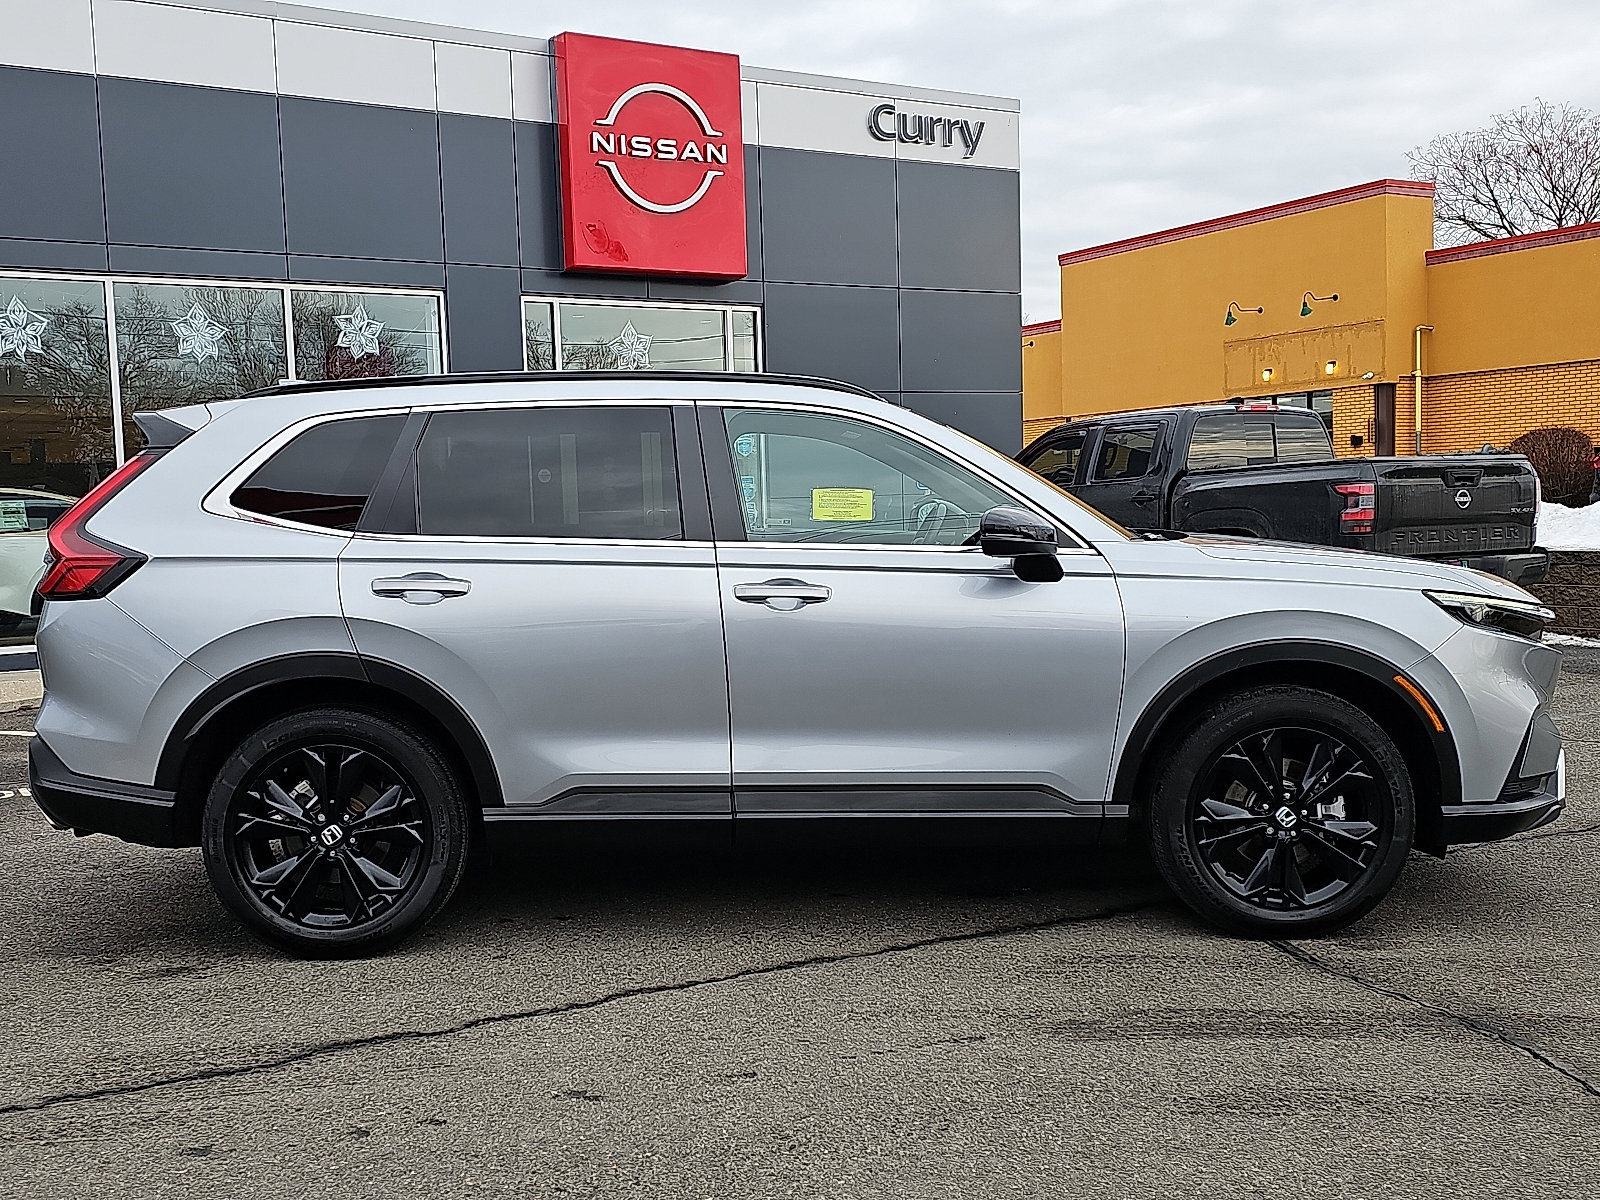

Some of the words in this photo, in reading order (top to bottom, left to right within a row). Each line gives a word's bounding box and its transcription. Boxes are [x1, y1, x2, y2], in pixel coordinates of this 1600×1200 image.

[590, 131, 728, 164] NISSAN
[867, 103, 985, 159] Curry
[1391, 526, 1519, 545] FRONTIER
